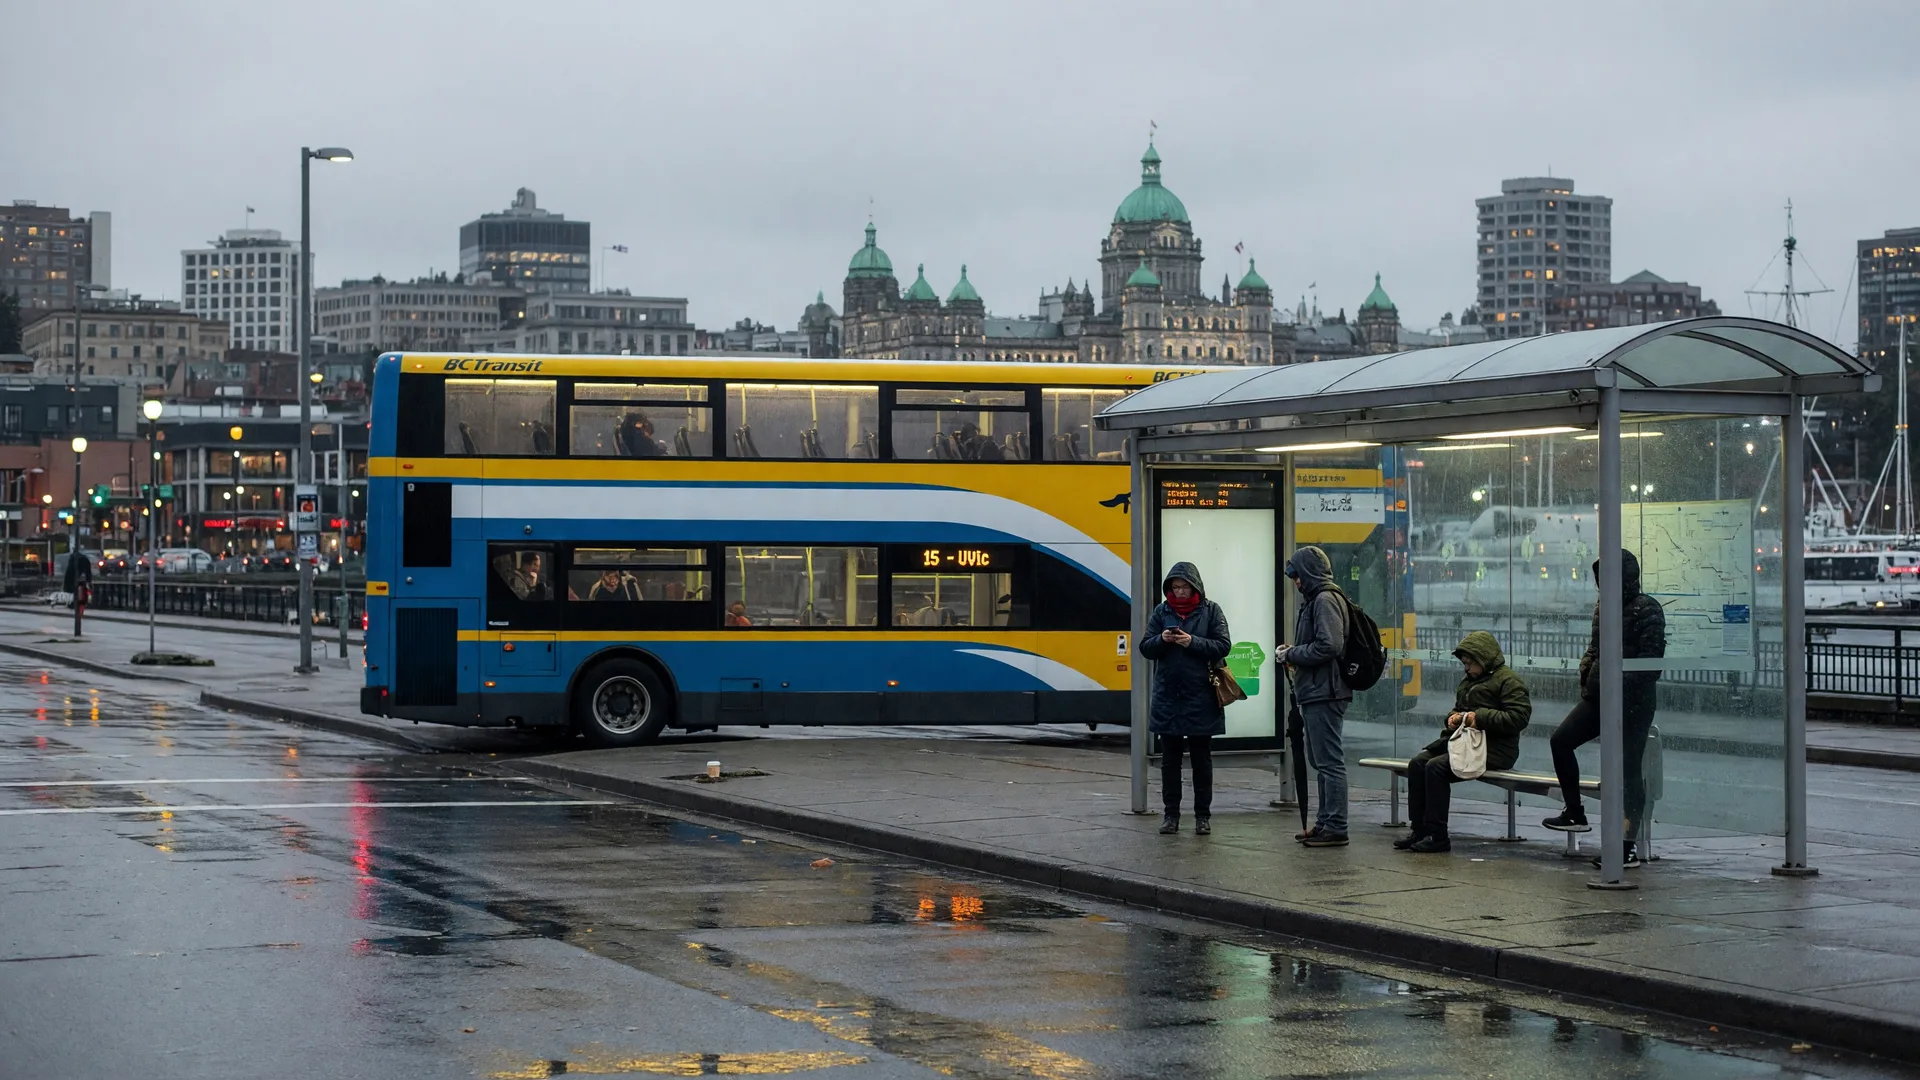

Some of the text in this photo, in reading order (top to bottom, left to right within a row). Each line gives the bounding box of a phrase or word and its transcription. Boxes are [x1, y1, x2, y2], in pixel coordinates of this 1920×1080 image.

[443, 358, 543, 372] BC Transit
[923, 549, 940, 566] 15
